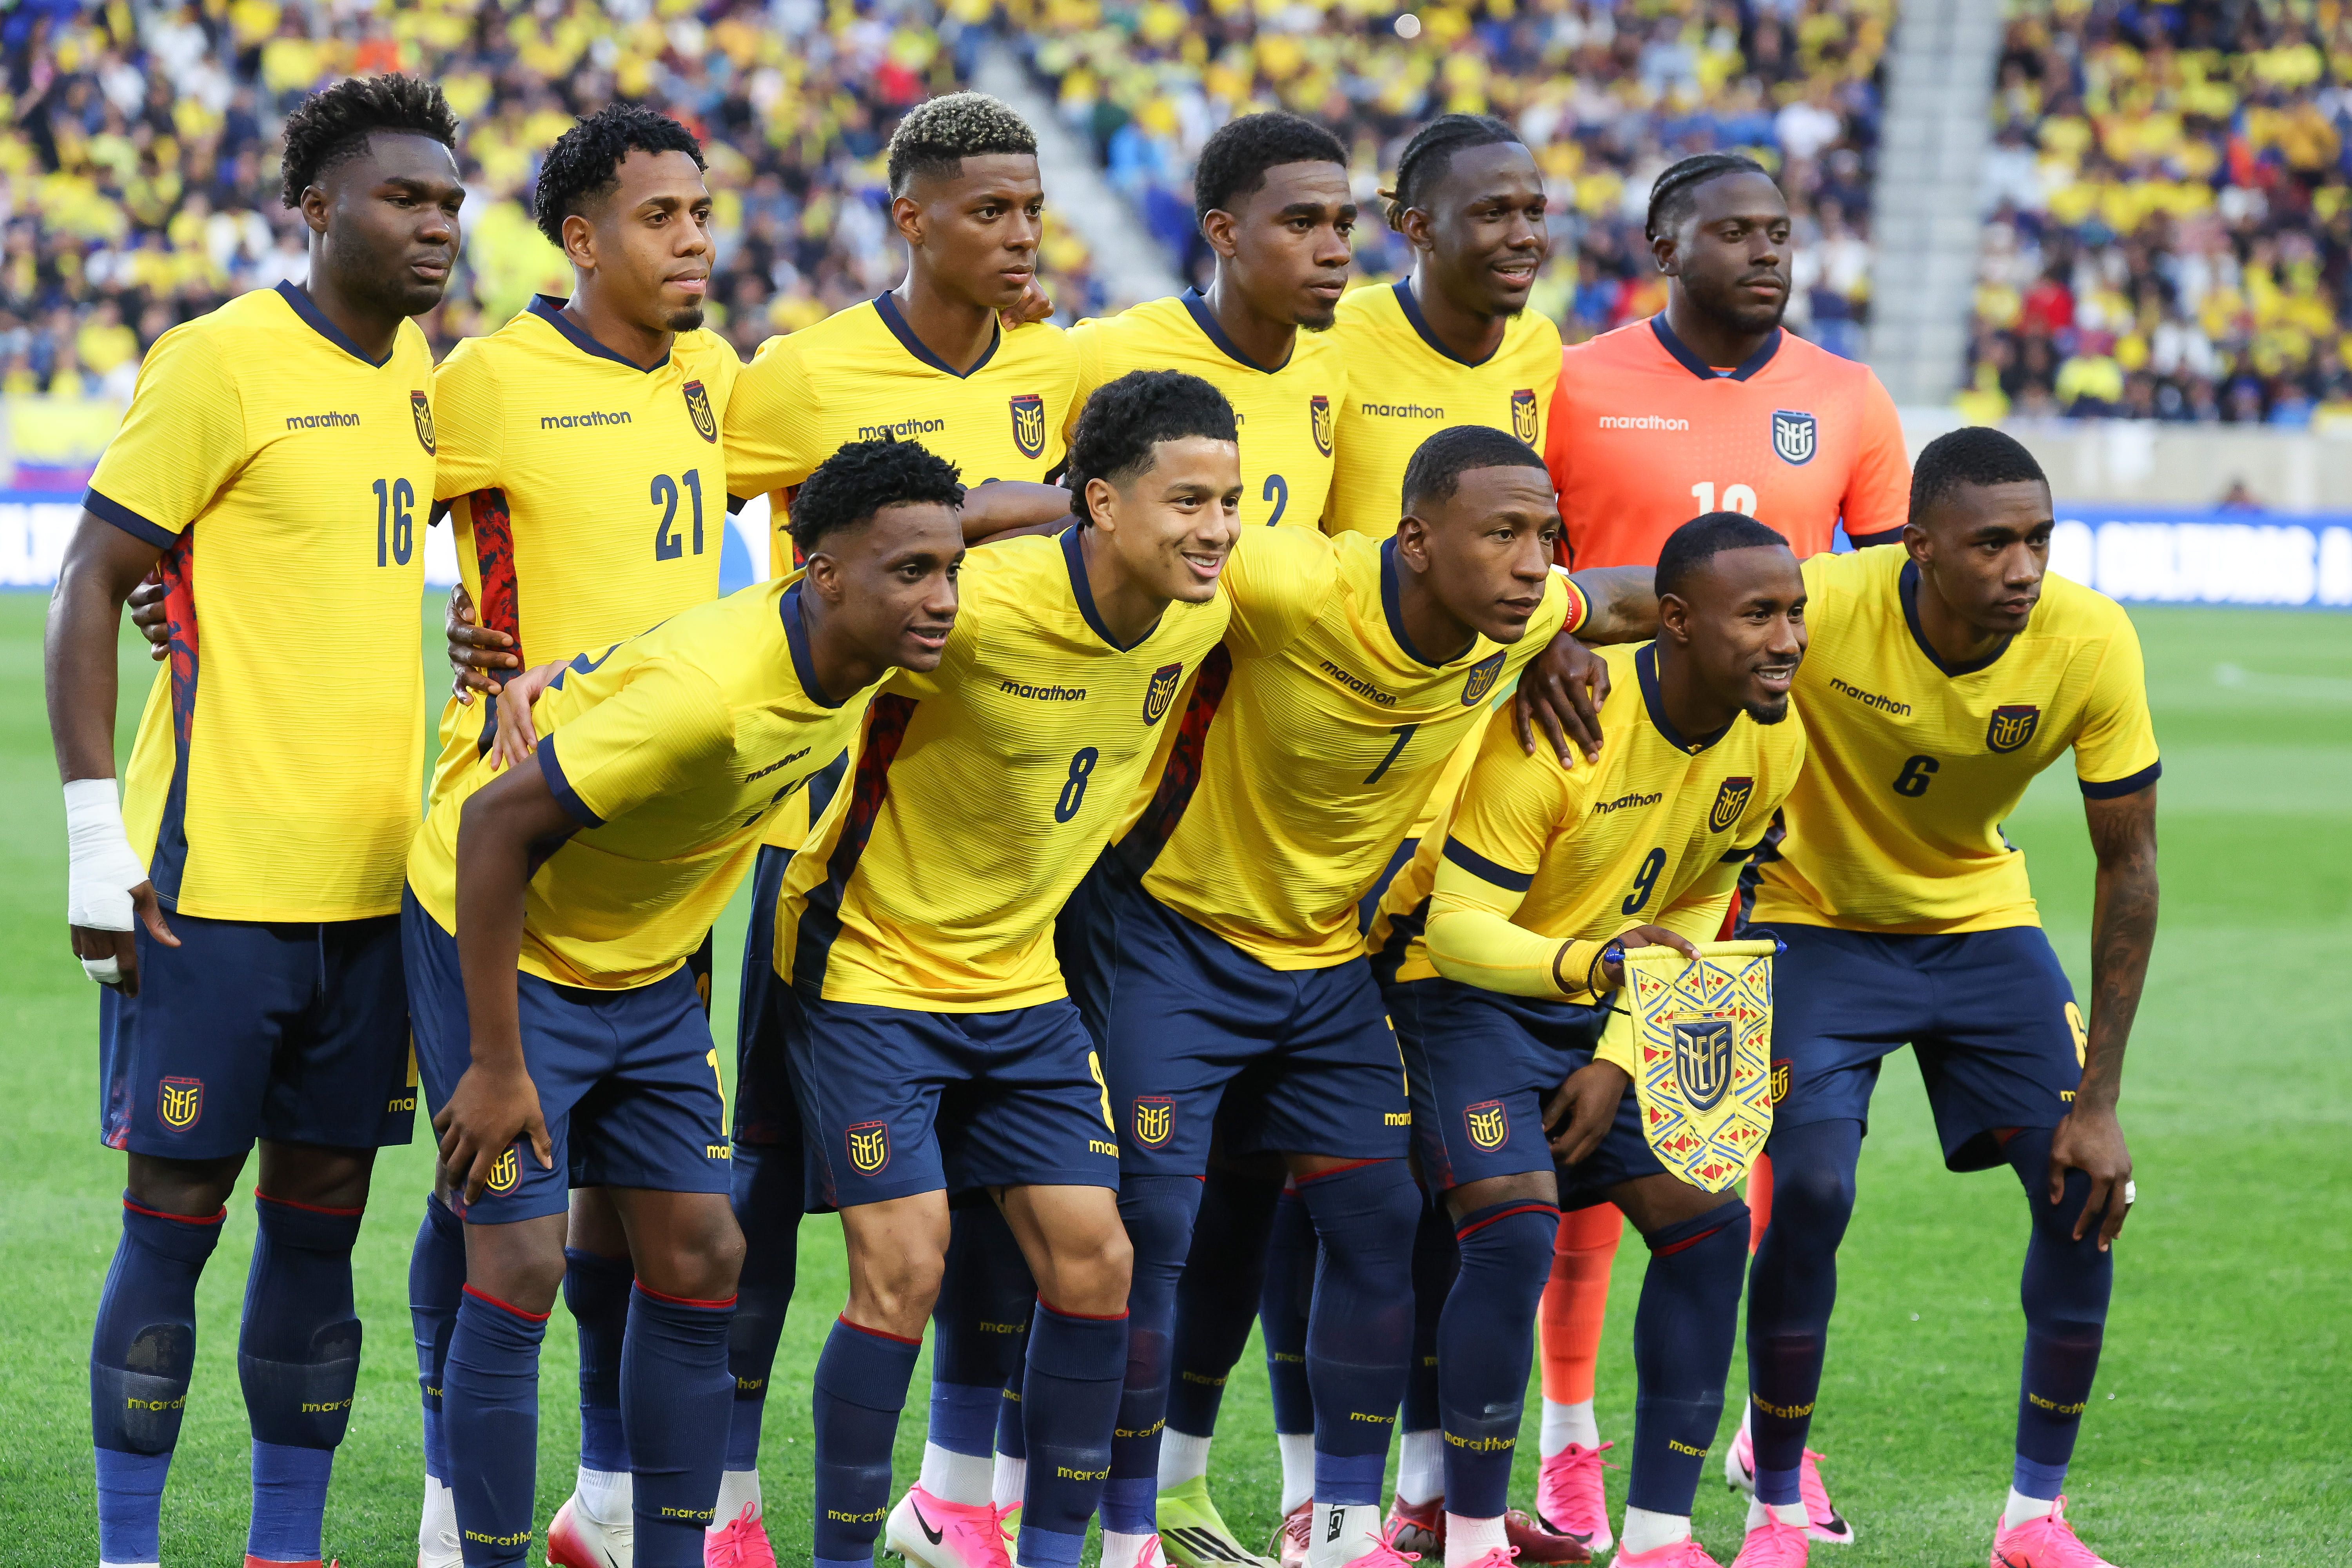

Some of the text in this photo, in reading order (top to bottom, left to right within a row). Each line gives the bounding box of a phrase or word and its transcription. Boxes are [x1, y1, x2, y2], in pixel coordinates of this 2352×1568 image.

[287, 411, 360, 430] marathon
[541, 412, 632, 429] marathon
[858, 419, 944, 439] marathon
[1362, 404, 1444, 419] marathon
[1599, 415, 1689, 431] marathon
[650, 469, 703, 561] 21
[1263, 474, 1288, 527] 2
[372, 478, 414, 567] 16
[1000, 681, 1086, 701] marathon
[1320, 660, 1396, 705] marathon
[1829, 678, 1911, 716] marathon
[745, 746, 811, 783] marathon
[1363, 723, 1420, 784] 7
[1054, 747, 1098, 823] 8
[1893, 755, 1939, 797] 6
[1592, 792, 1662, 815] marathon
[1622, 847, 1666, 915] 9
[1445, 1430, 1515, 1451] marathon
